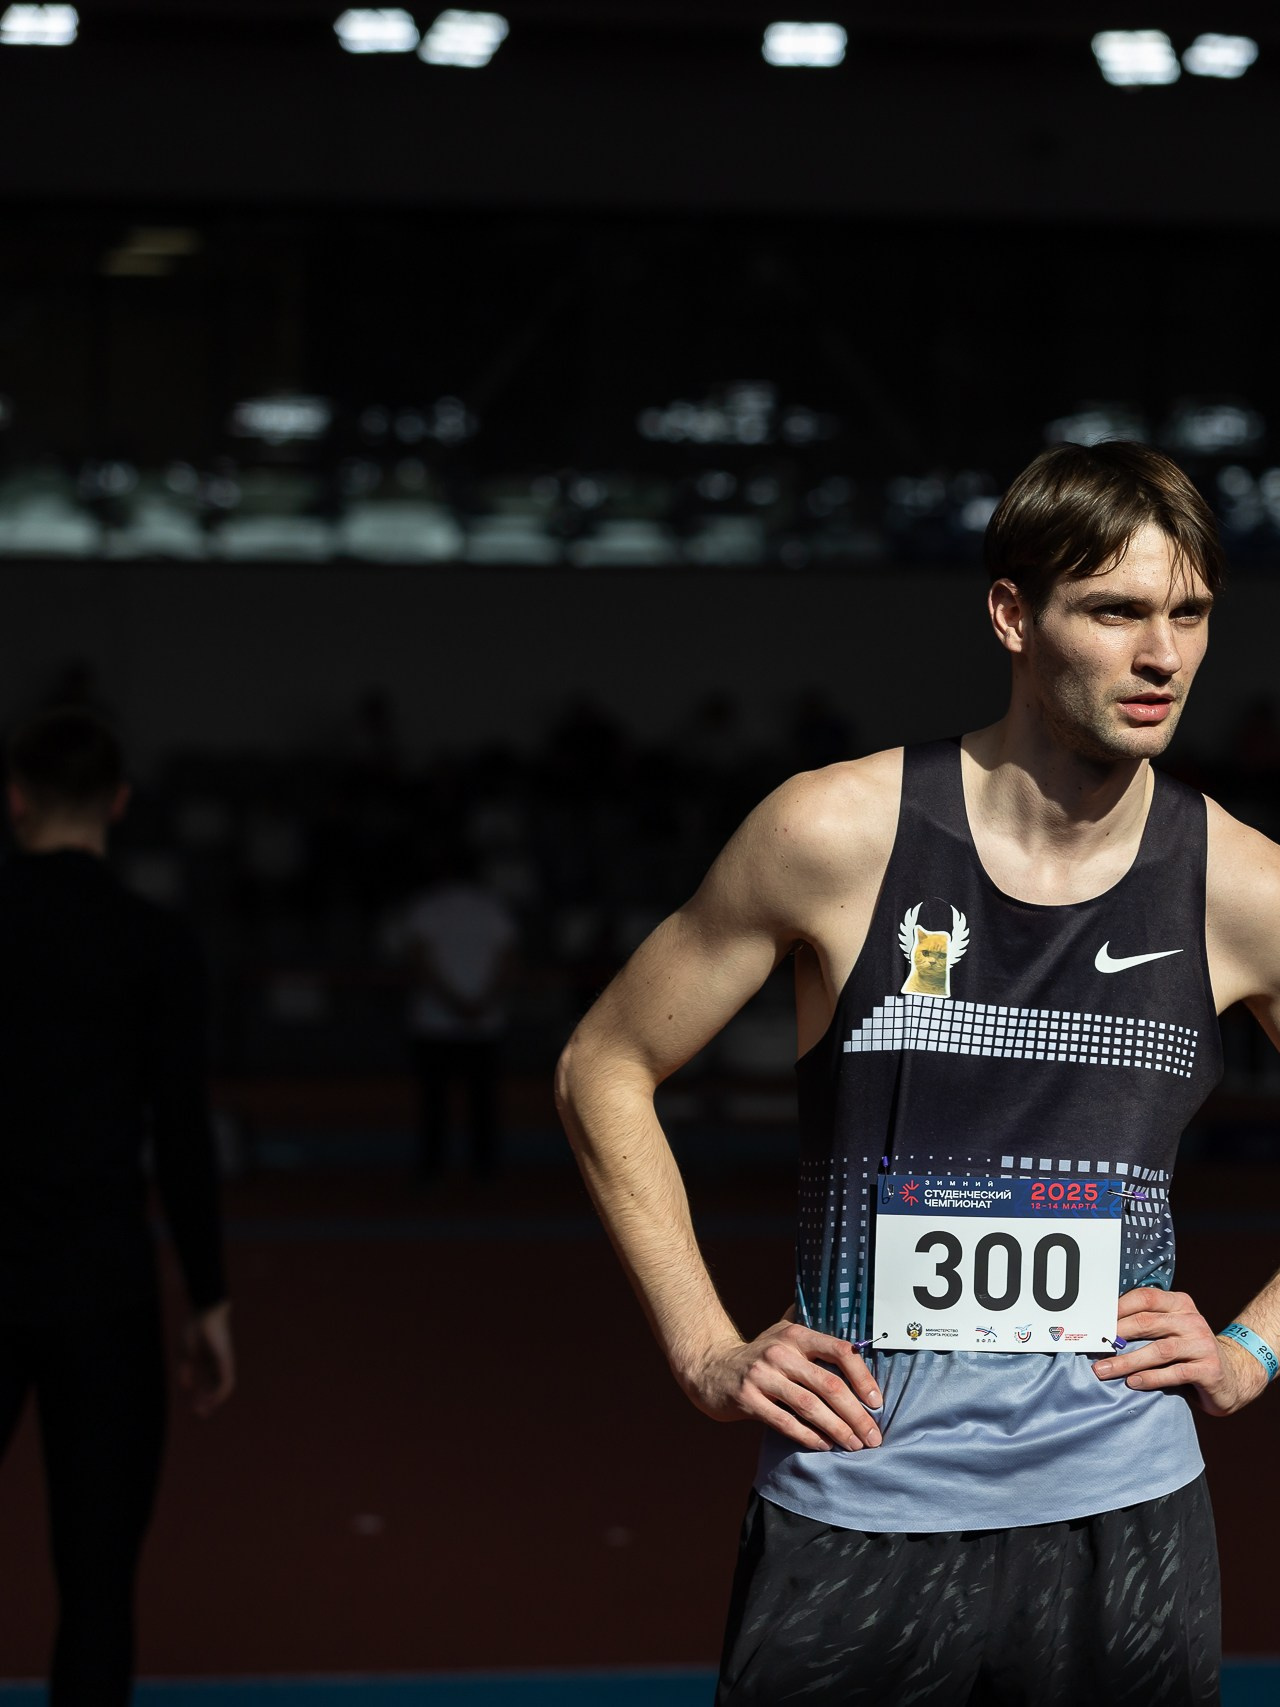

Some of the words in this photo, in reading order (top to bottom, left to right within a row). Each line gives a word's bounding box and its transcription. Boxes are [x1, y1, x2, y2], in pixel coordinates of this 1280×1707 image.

[924, 1180, 994, 1188] ЗИМНИЙ
[924, 1189, 1012, 1200] СТУДЕНЧЕСКИЙ
[1031, 1182, 1098, 1201] 2025
[924, 1199, 993, 1209] ЧЕМПИОНАТ
[1062, 1202, 1098, 1210] МАРТА
[913, 1230, 1081, 1312] 300
[1228, 1325, 1249, 1338] 216
